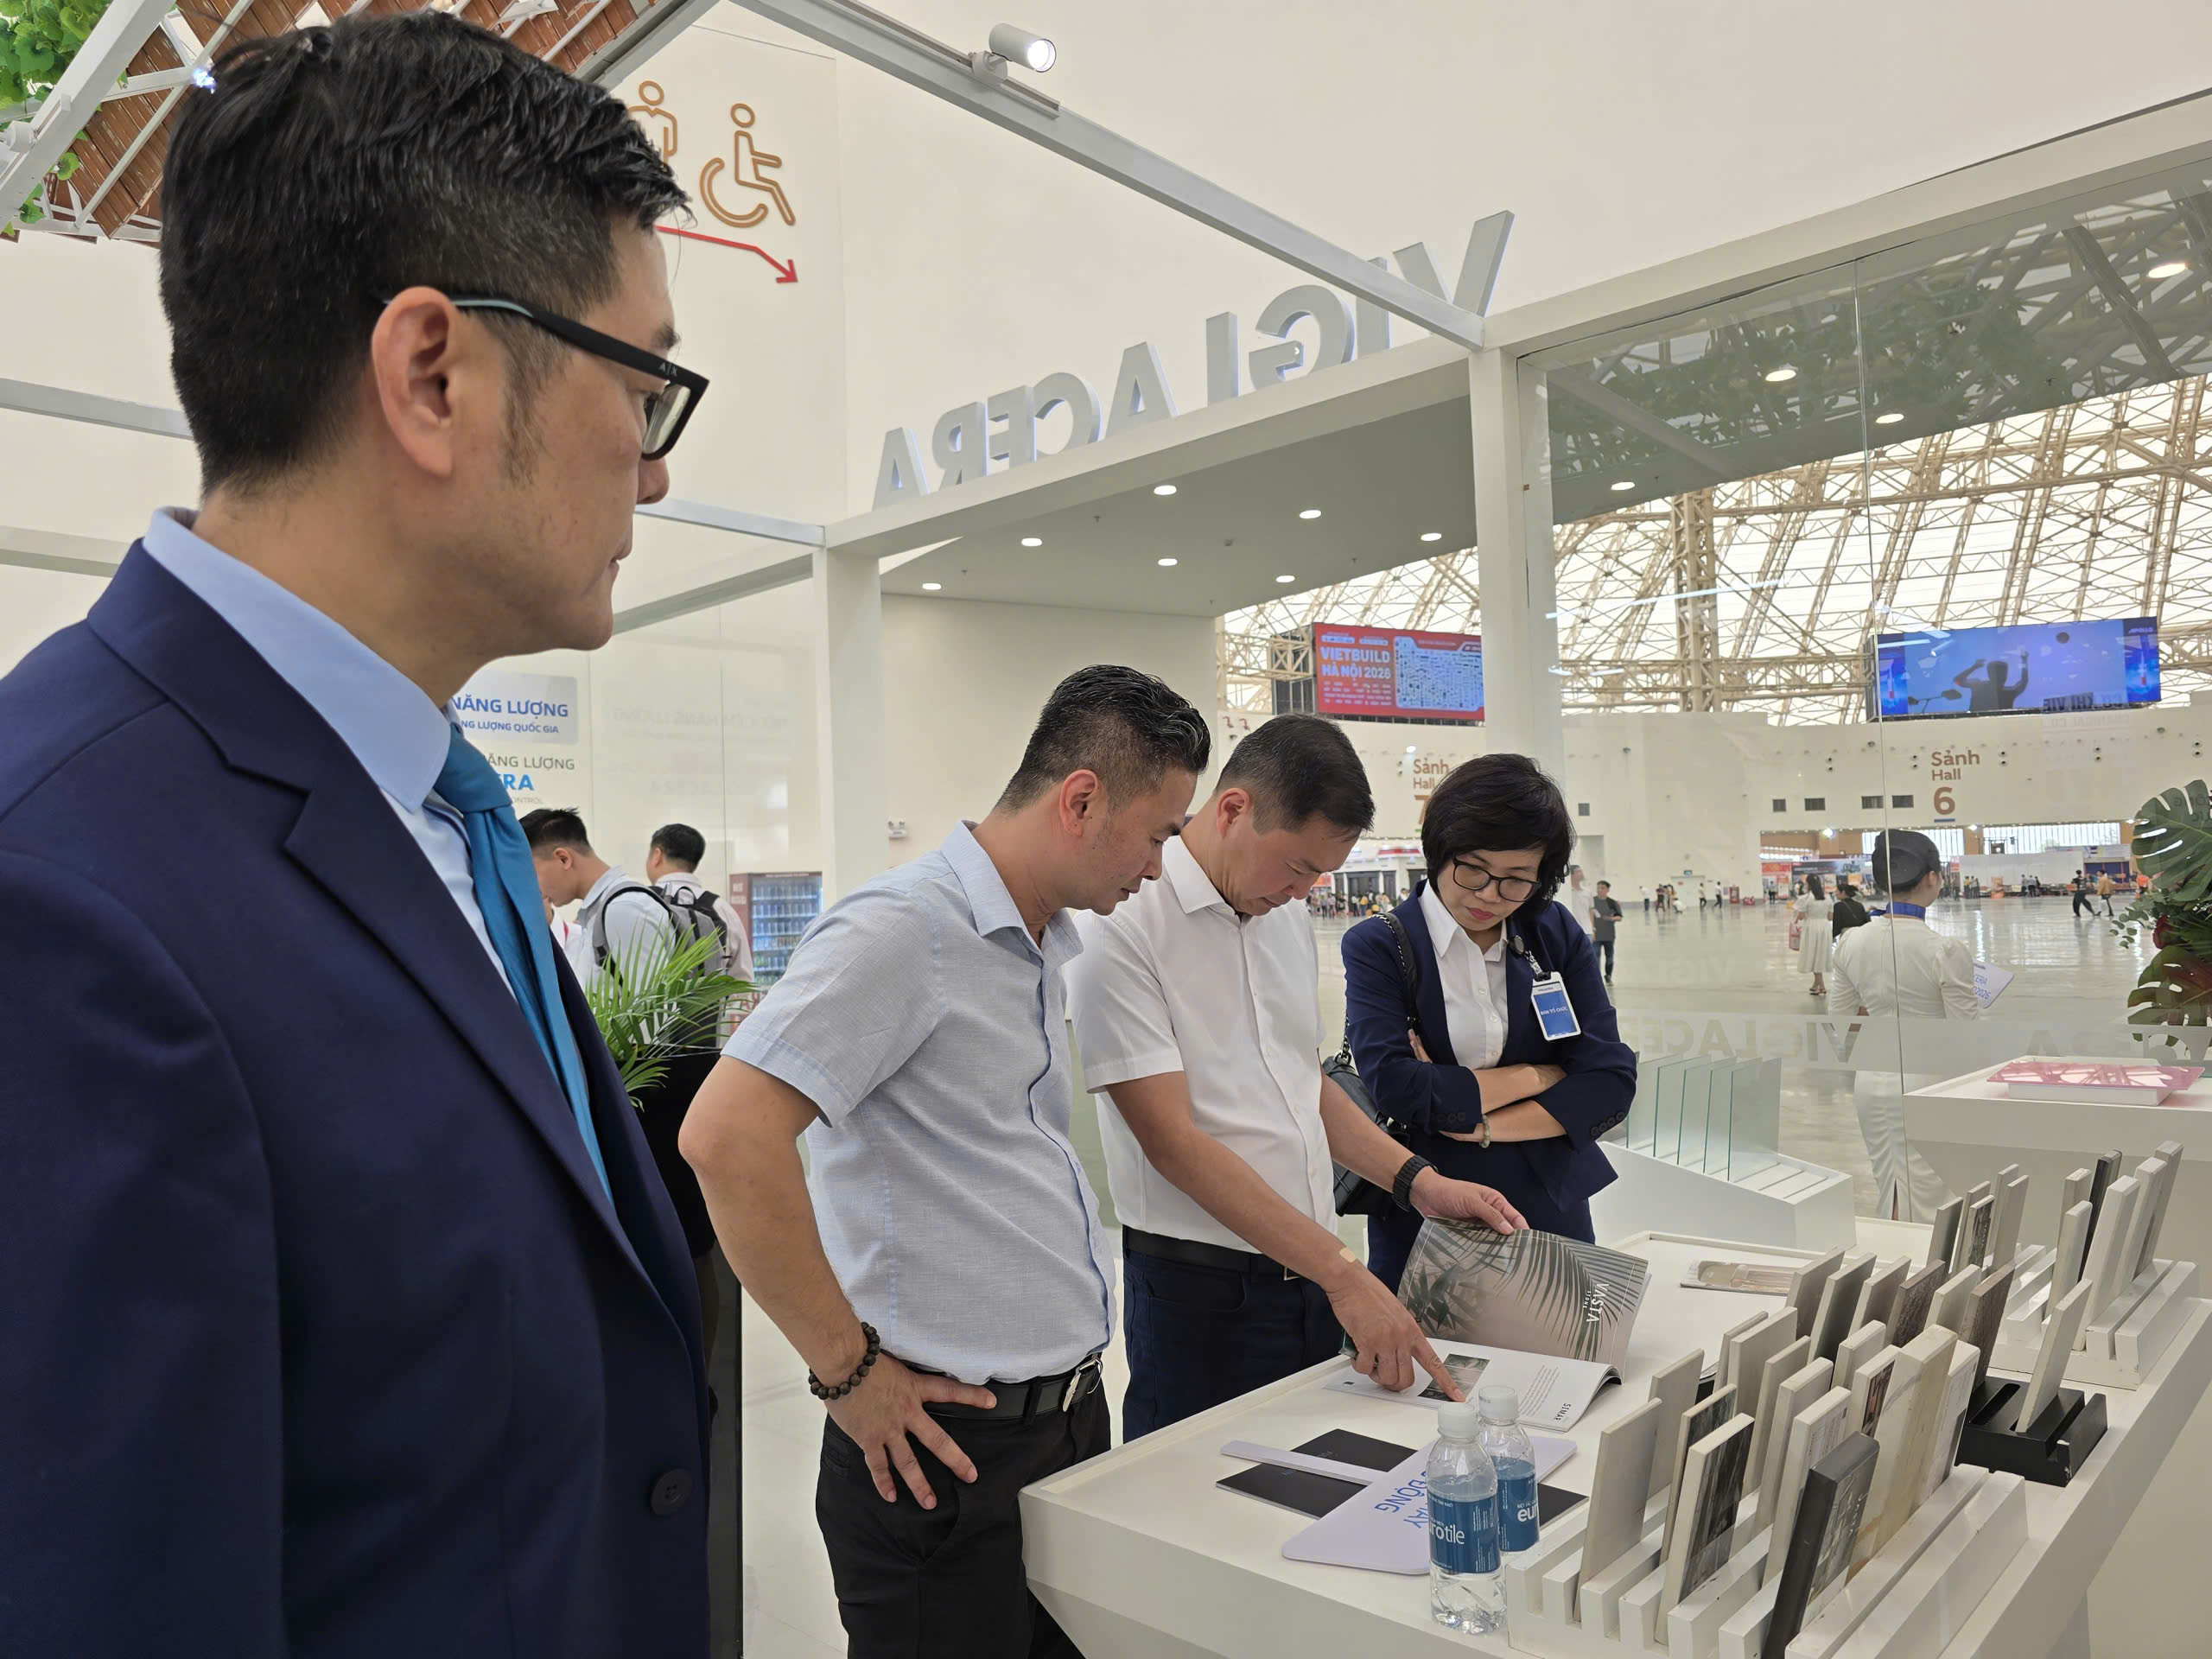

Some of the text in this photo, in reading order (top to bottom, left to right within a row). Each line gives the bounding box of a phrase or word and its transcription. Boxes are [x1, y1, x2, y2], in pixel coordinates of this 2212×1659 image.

[1319, 645, 1390, 664] VIETBUILD
[507, 700, 569, 719] LƯỢNG
[461, 720, 475, 728] NG
[487, 753, 518, 767] ĂNG
[1413, 758, 1449, 774] Sảnh
[1931, 750, 1980, 766] Sảnh
[499, 774, 534, 791] RA
[1931, 768, 1961, 781] Hall
[1413, 778, 1436, 790] Hall
[1934, 786, 1955, 815] 6
[1586, 1283, 1610, 1322] VASTA
[1429, 1522, 1465, 1545] rotile
